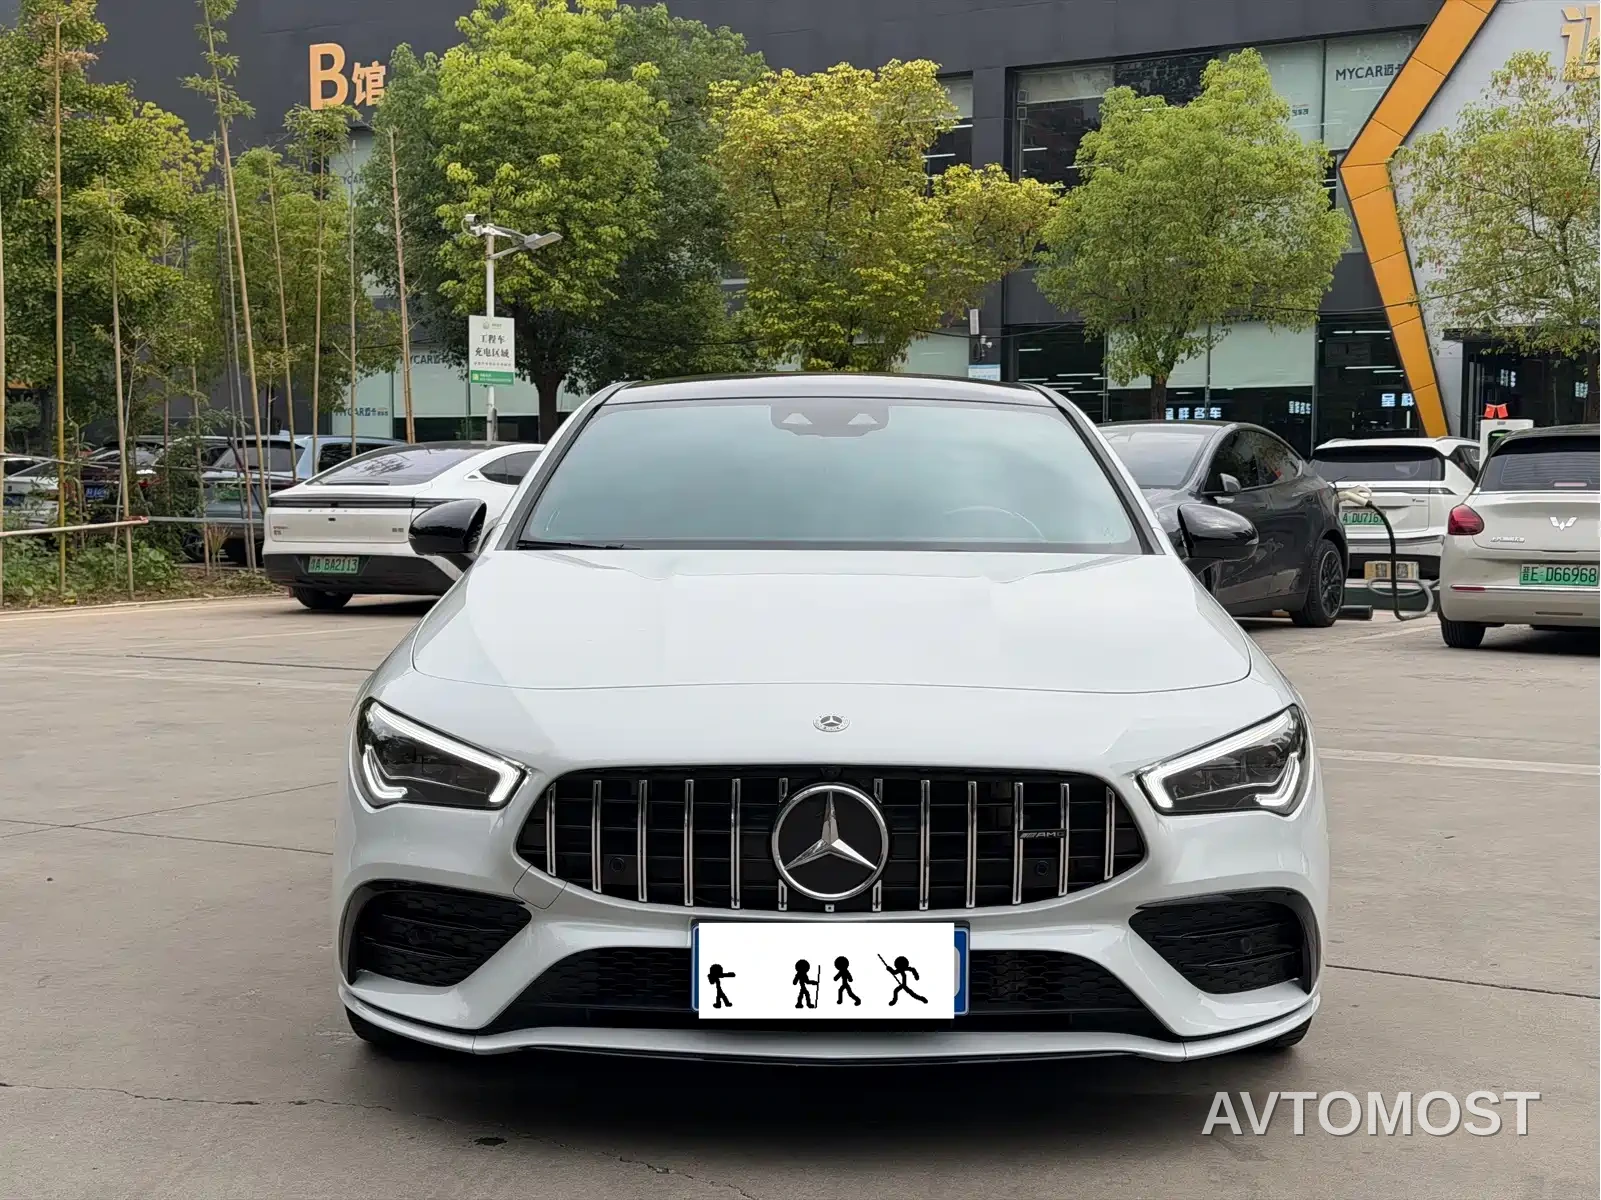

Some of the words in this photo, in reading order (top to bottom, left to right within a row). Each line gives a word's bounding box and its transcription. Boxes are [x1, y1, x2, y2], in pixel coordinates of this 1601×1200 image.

[475, 347, 510, 359] 充电区域
[1352, 512, 1384, 524] DU716
